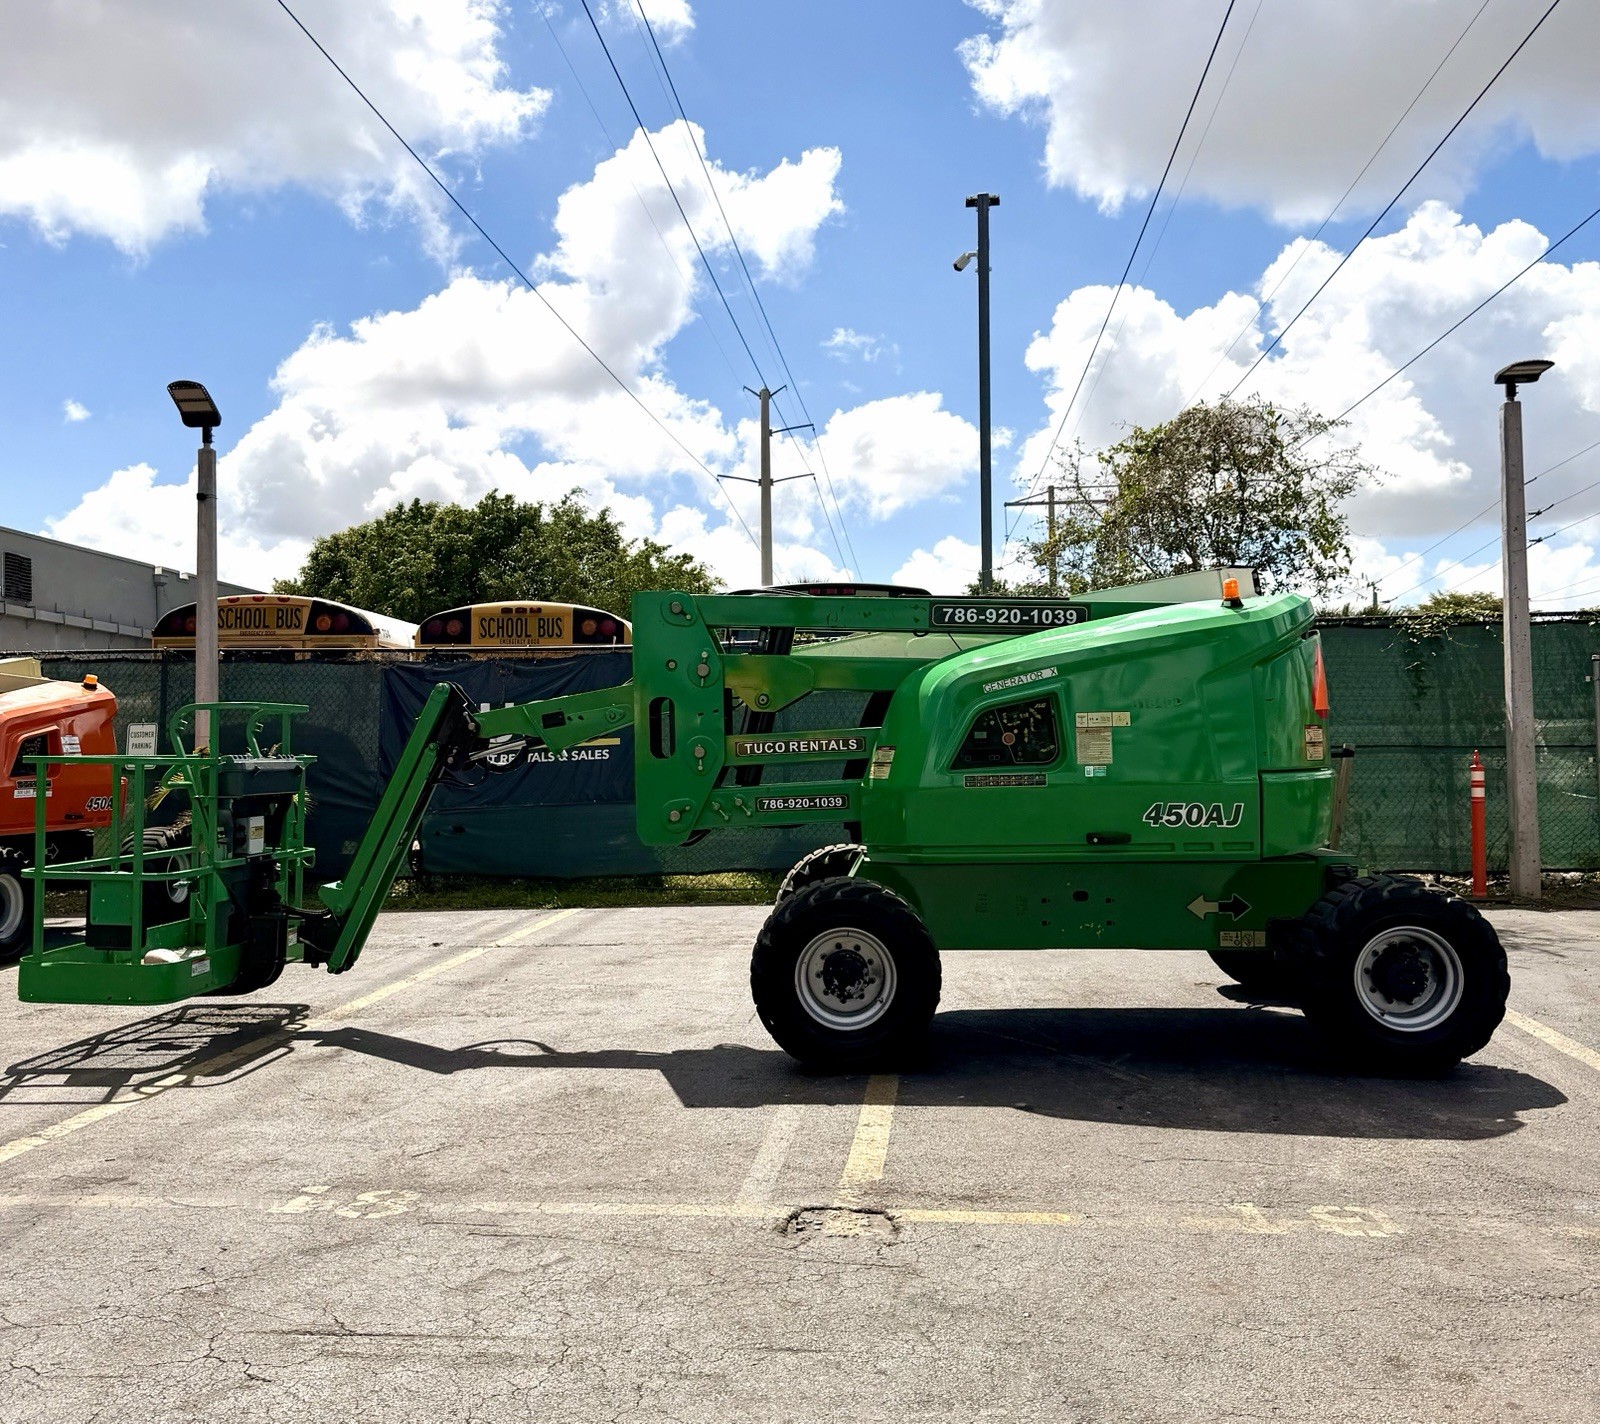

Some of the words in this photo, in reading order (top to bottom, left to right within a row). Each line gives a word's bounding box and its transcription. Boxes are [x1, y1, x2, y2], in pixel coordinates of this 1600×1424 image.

[218, 607, 270, 629] SCHOOL
[276, 607, 301, 629] BUS
[942, 608, 1077, 624] 786-920-1039
[480, 617, 532, 638] SCHOOL
[538, 617, 563, 638] BUS
[983, 671, 1043, 692] GENERATOR
[1050, 667, 1057, 677] X
[745, 742, 786, 754] TUCO
[789, 739, 857, 753] RENTALS
[500, 751, 555, 764] RETALS
[571, 749, 610, 761] SALES
[85, 796, 113, 812] 450A
[762, 797, 843, 809] 786-920-1039
[1143, 802, 1244, 827] 450AJ
